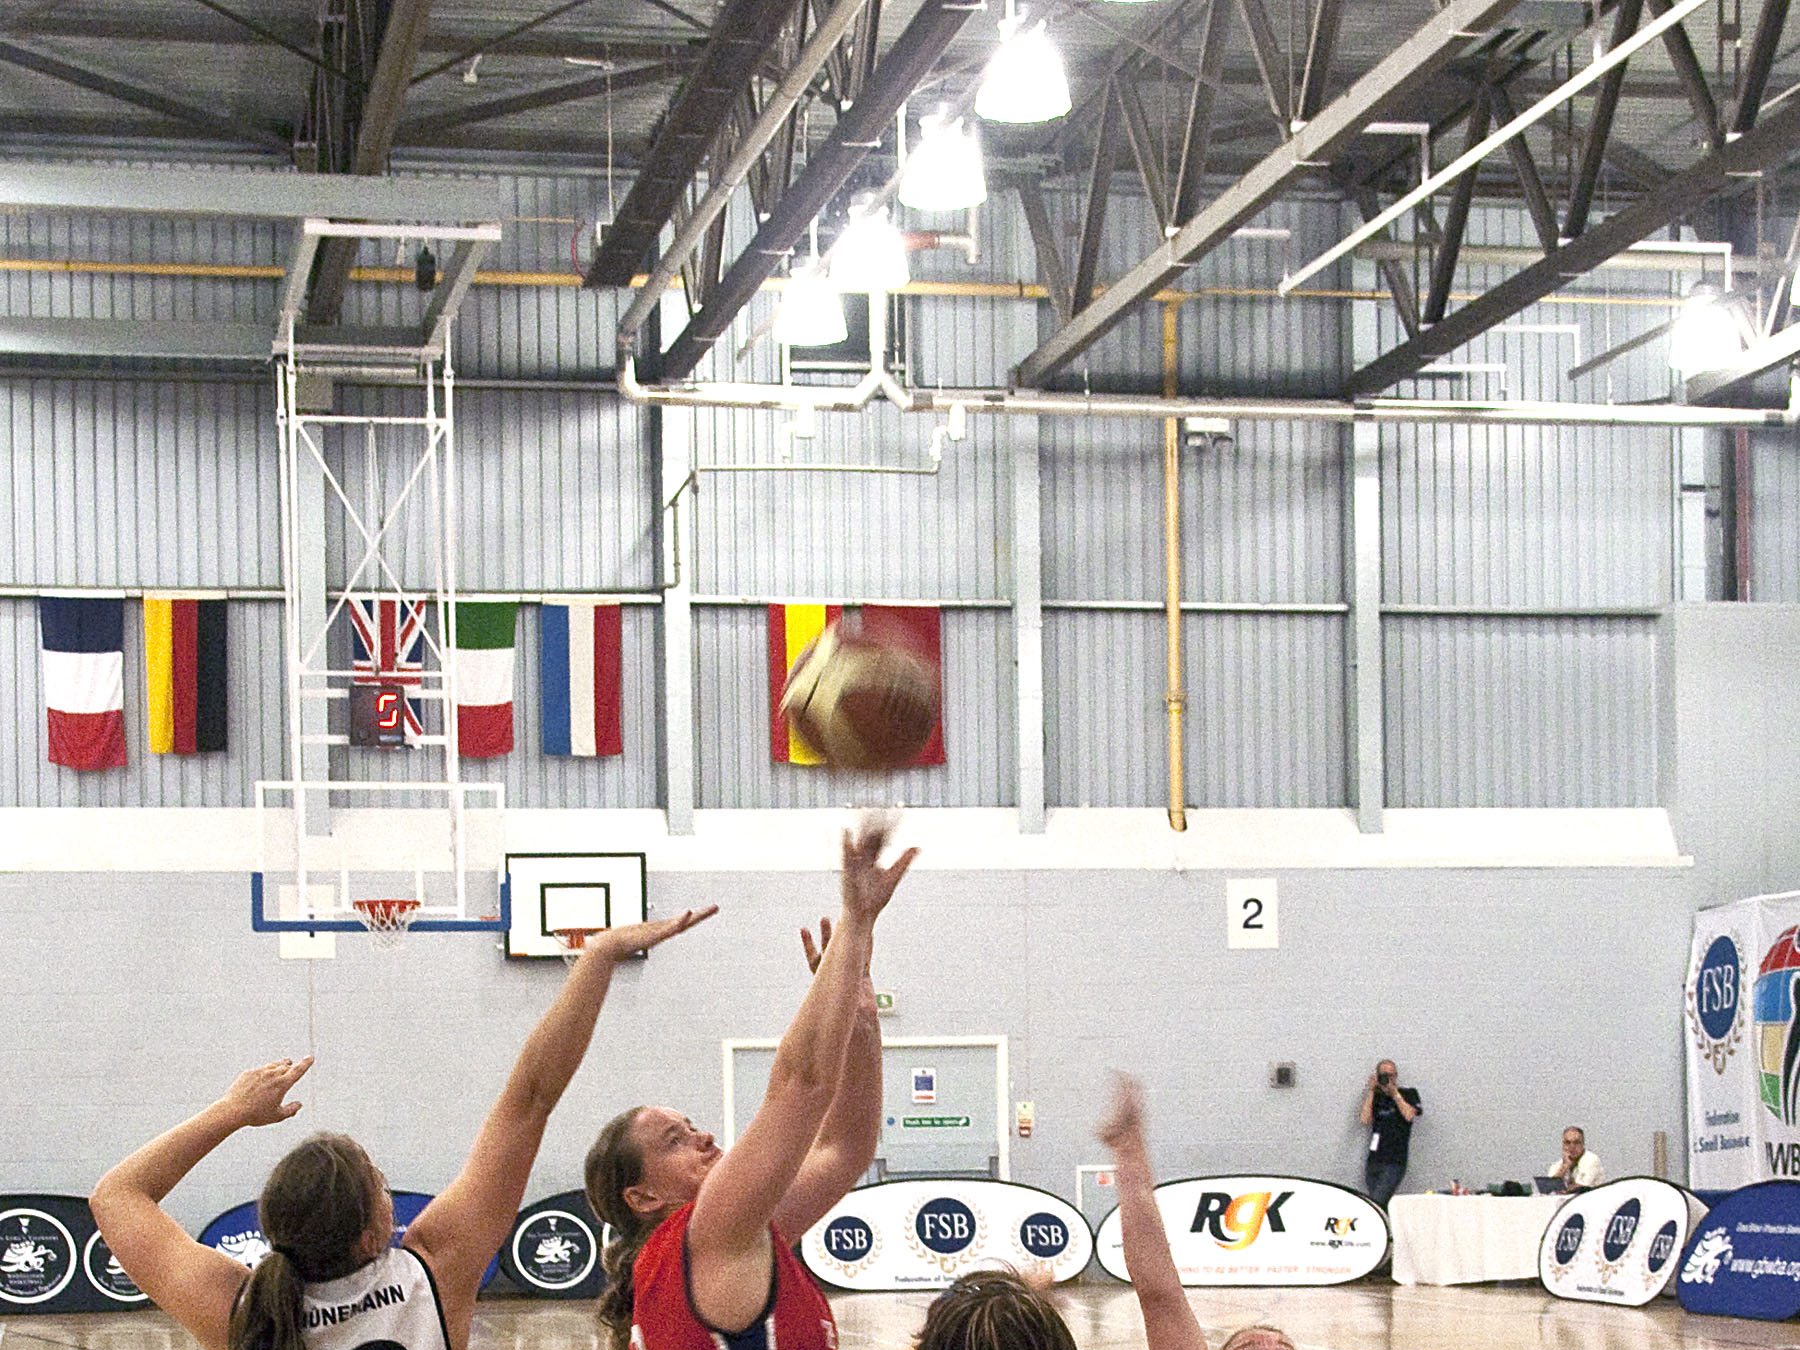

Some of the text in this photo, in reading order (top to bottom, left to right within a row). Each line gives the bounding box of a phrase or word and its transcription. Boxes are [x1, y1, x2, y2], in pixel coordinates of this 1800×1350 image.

[1241, 897, 1265, 930] 2
[1703, 964, 1735, 1013] FSB
[829, 1227, 869, 1251] FSB
[924, 1212, 970, 1240] FSB
[1025, 1224, 1064, 1247] FSB
[1557, 1227, 1582, 1251] FSB
[1606, 1214, 1636, 1245] FSB
[1650, 1234, 1674, 1260] FSB
